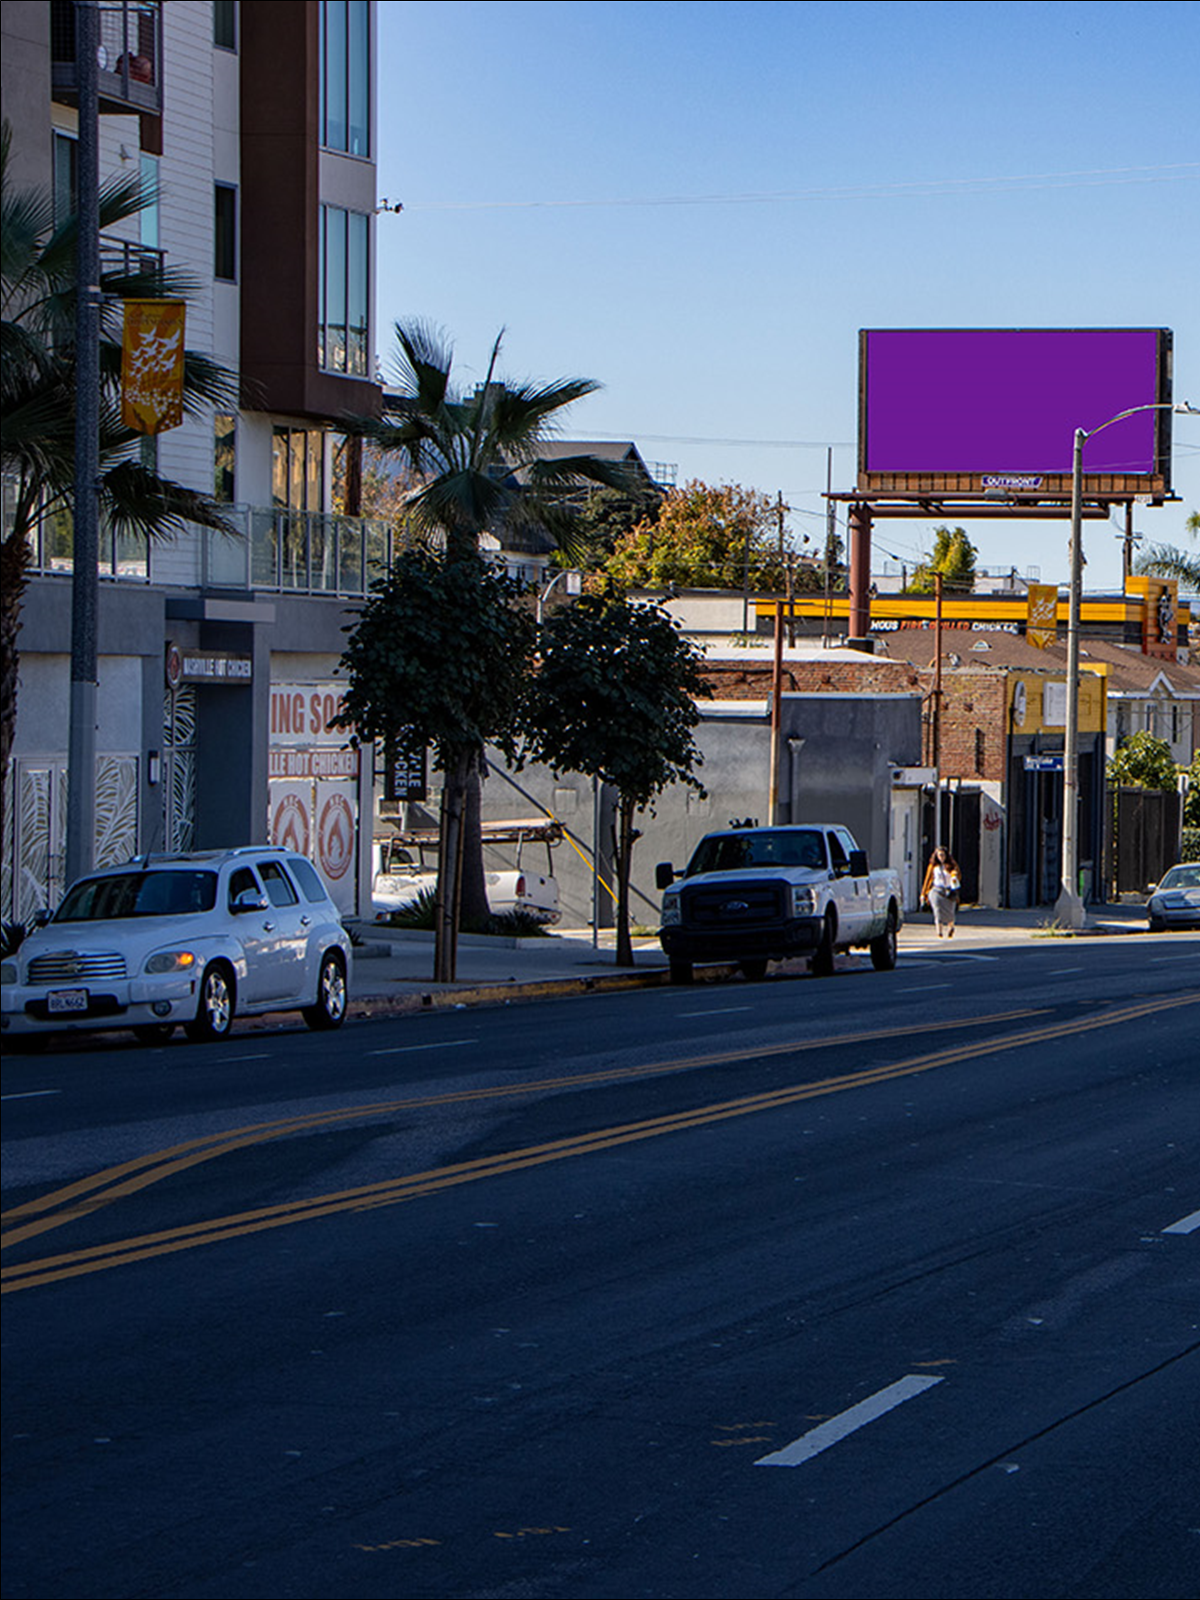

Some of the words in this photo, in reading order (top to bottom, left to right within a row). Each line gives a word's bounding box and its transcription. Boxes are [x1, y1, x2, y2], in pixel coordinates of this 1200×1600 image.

[986, 475, 1034, 486] OUTFRONT
[271, 693, 305, 735] ING
[287, 752, 310, 775] HOT
[311, 752, 357, 776] CHICKEN
